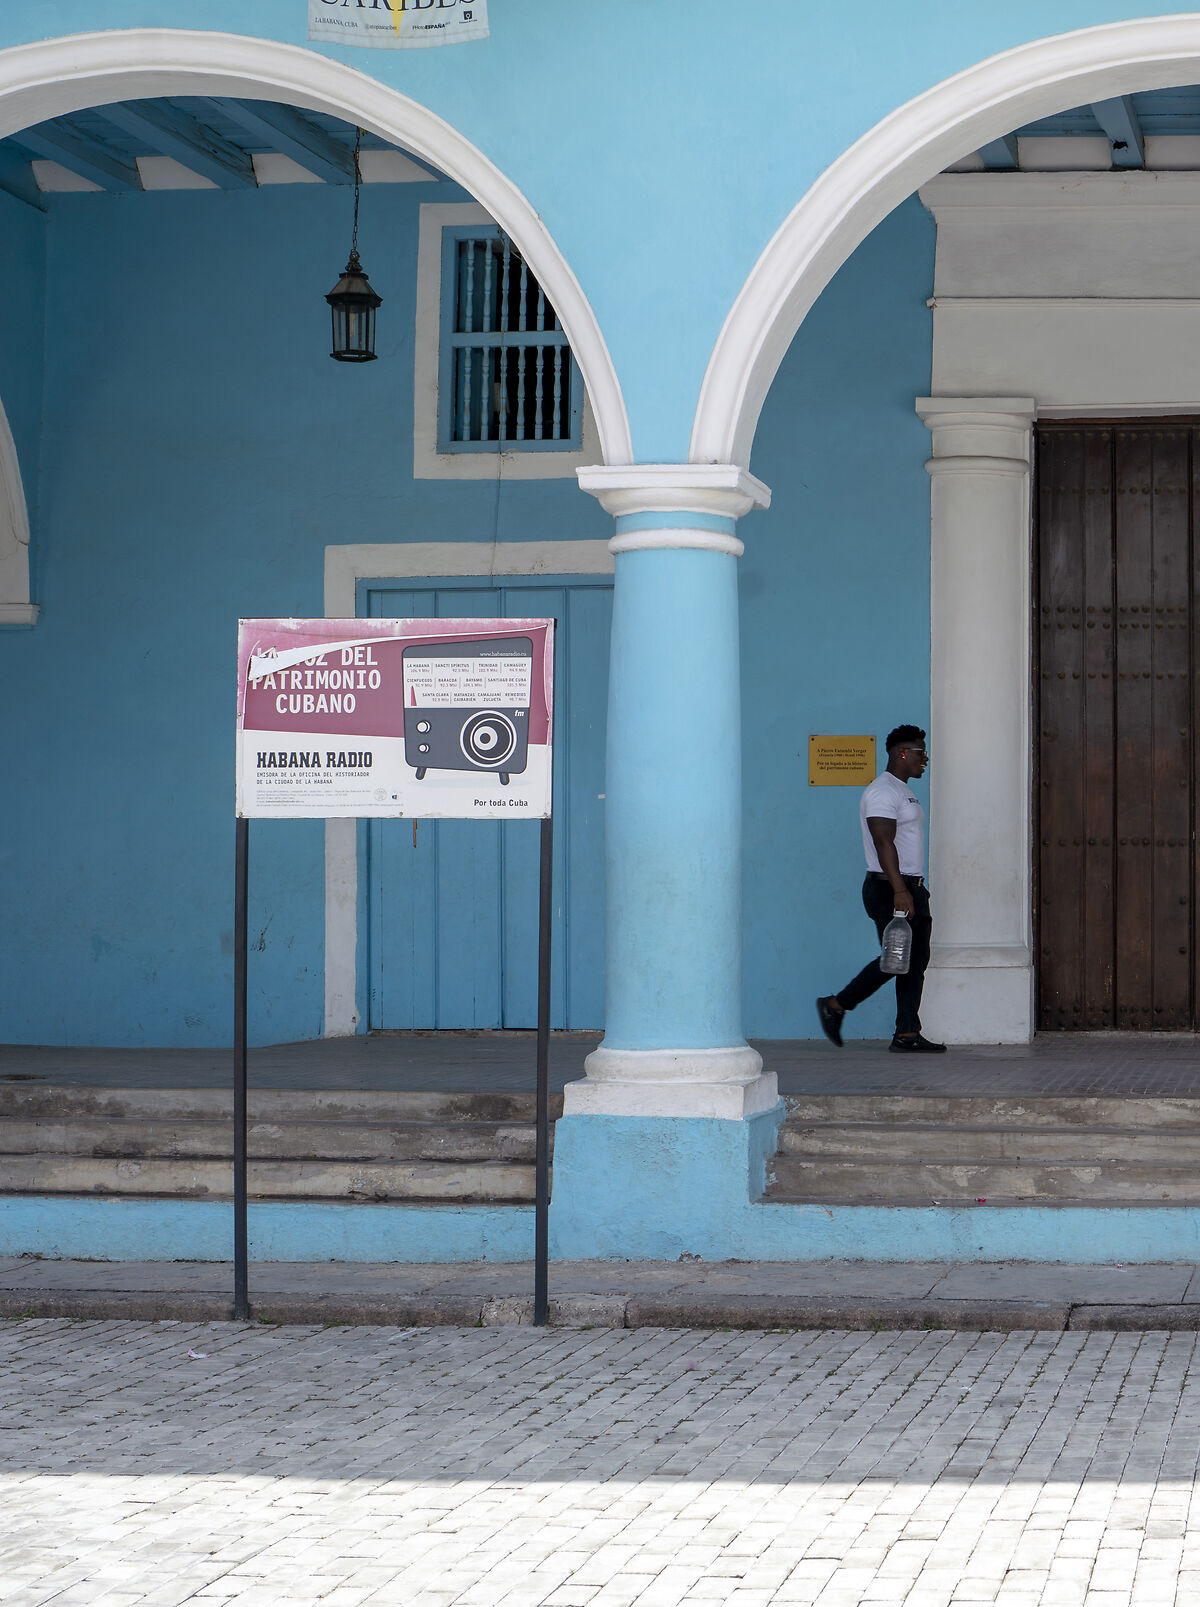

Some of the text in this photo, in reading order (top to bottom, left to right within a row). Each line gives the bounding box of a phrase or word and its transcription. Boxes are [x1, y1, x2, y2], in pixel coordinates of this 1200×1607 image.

[341, 647, 378, 666] DEL
[252, 670, 382, 690] PATRIMONIO
[276, 694, 356, 713] CUBANO
[256, 752, 373, 768] HABANA RADIO
[474, 799, 528, 807] Por toda Cuba
